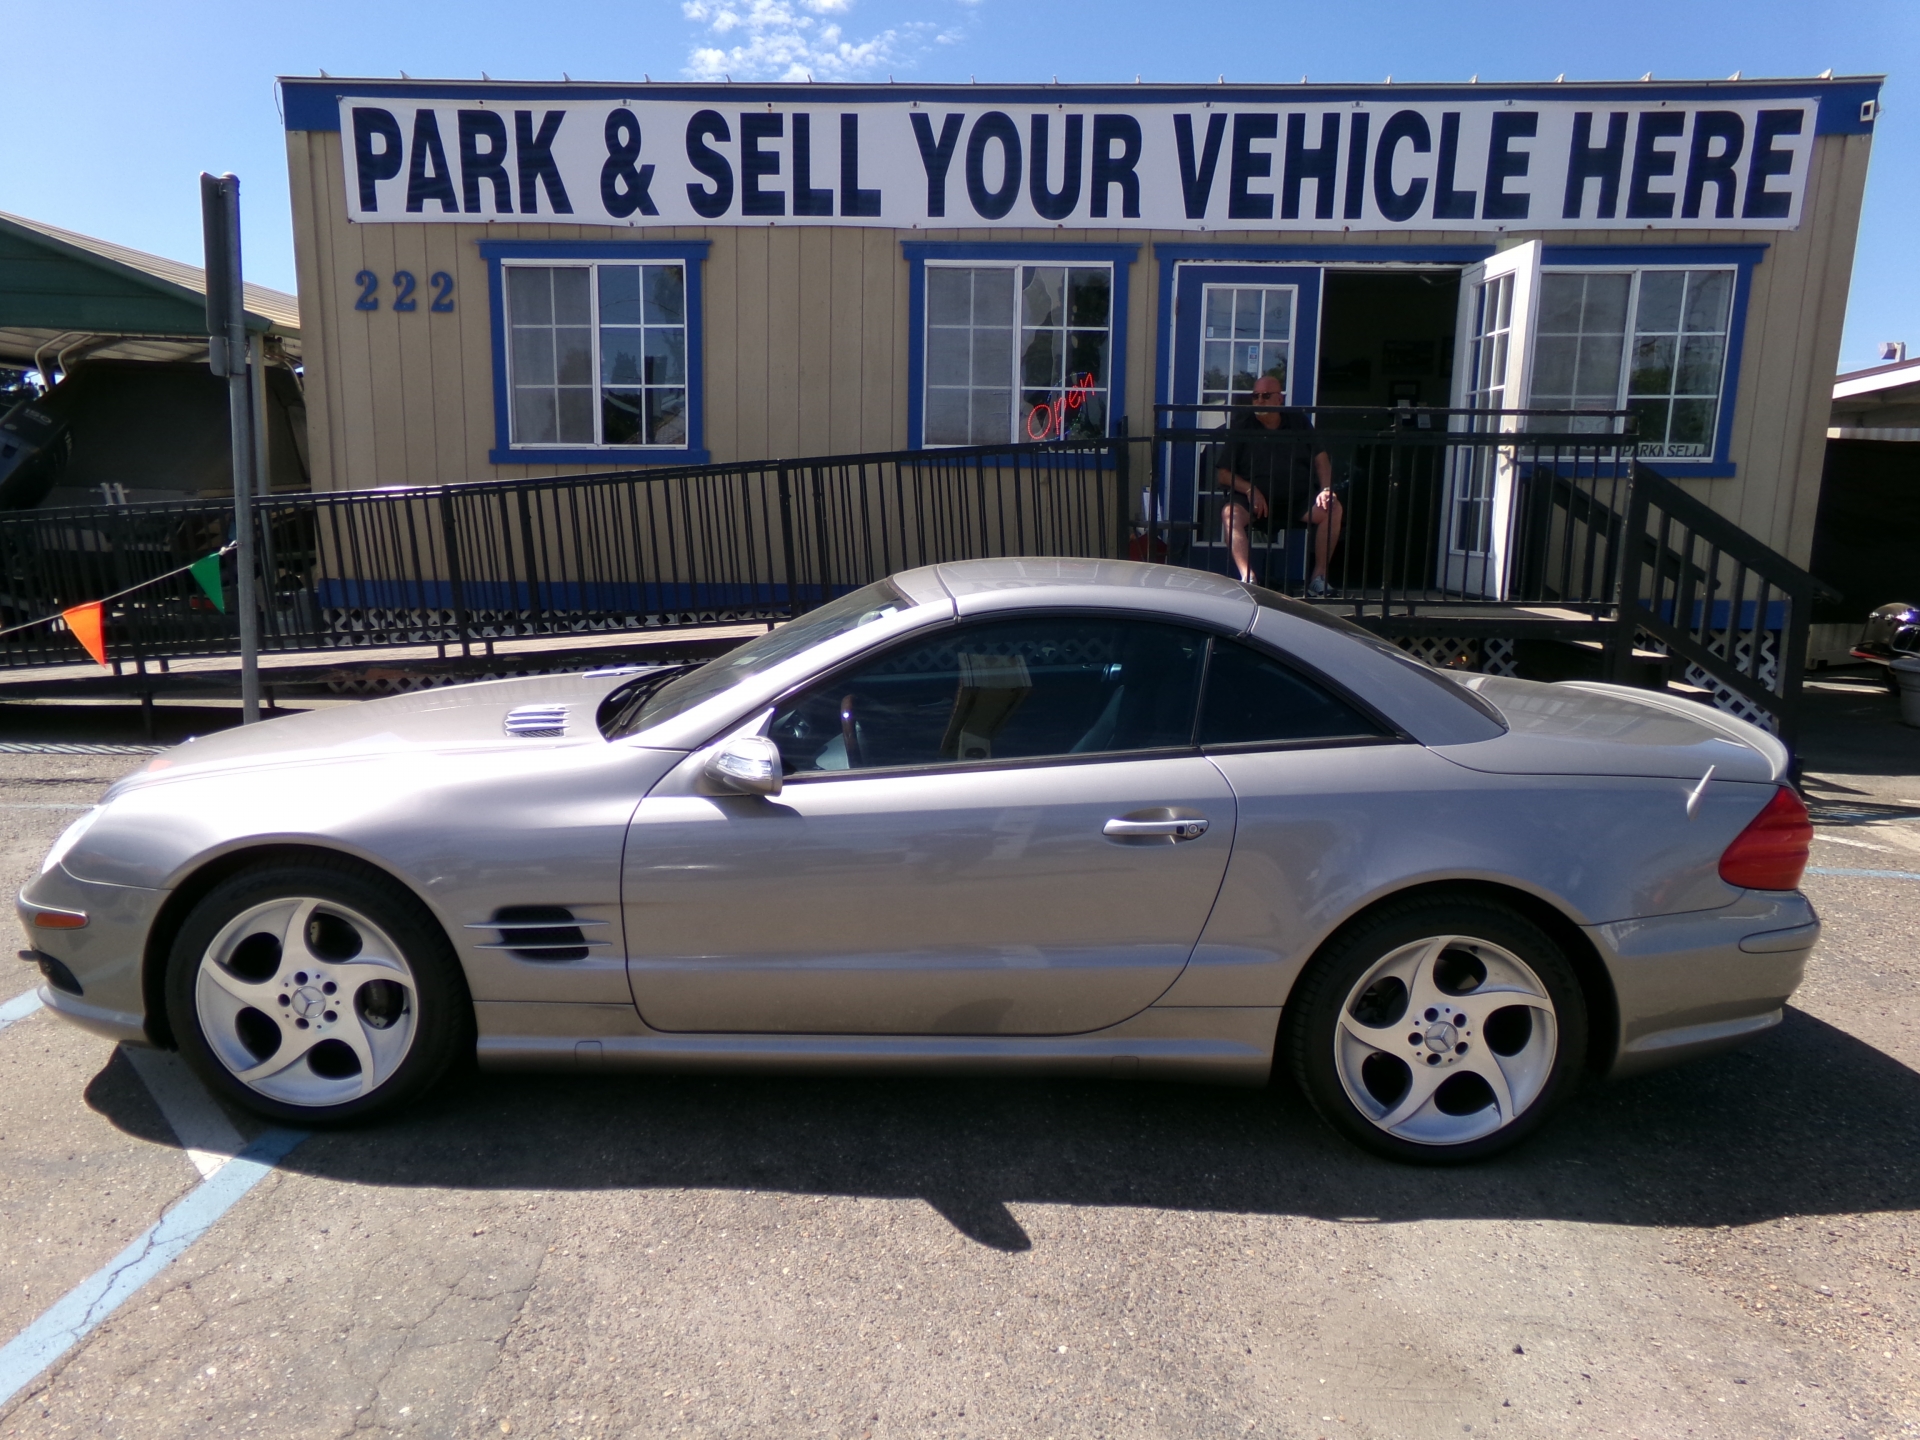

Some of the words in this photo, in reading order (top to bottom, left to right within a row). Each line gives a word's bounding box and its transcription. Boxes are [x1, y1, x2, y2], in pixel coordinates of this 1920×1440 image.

[351, 106, 575, 215] PARK
[600, 108, 660, 219] &
[685, 109, 882, 218] SELL
[908, 110, 1144, 221] YOUR
[1172, 109, 1539, 223] VEHICLE
[1561, 108, 1805, 220] HERE
[354, 269, 455, 312] 222
[1027, 372, 1096, 440] Open
